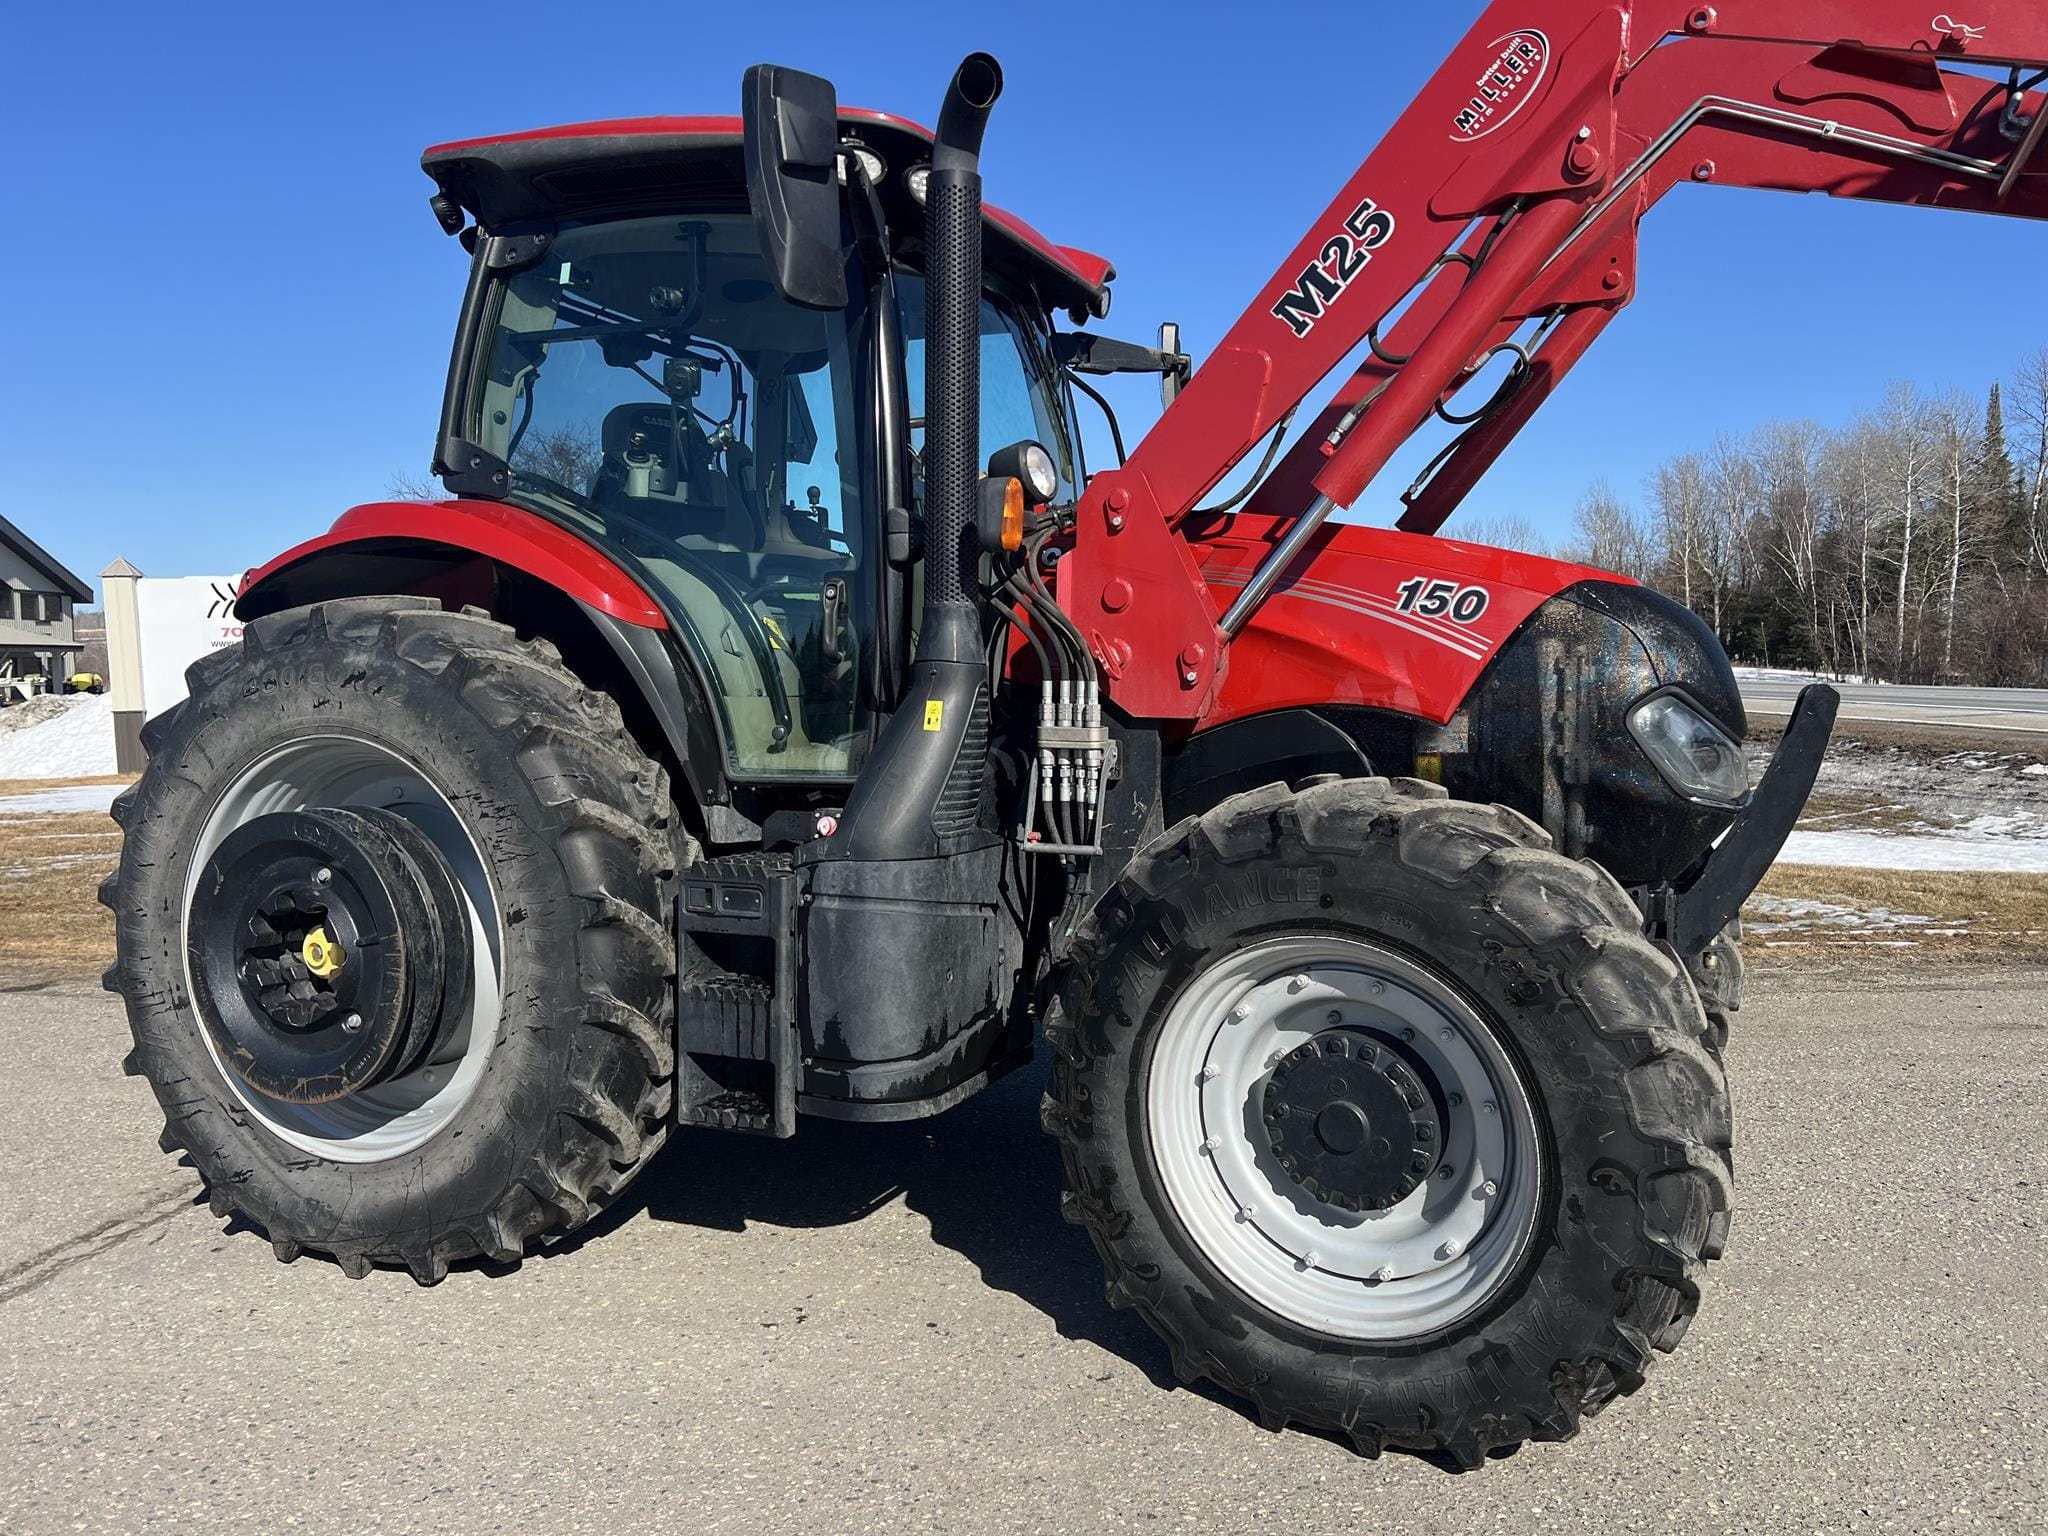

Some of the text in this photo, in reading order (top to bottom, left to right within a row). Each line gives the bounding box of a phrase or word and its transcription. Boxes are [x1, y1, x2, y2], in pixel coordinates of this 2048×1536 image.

[1454, 42, 1538, 132] MILLER
[1467, 54, 1541, 134] farm loaders
[1476, 37, 1522, 87] better built
[1270, 198, 1395, 338] M25
[1396, 576, 1489, 624] 150
[1122, 866, 1322, 998] ALLIANCE
